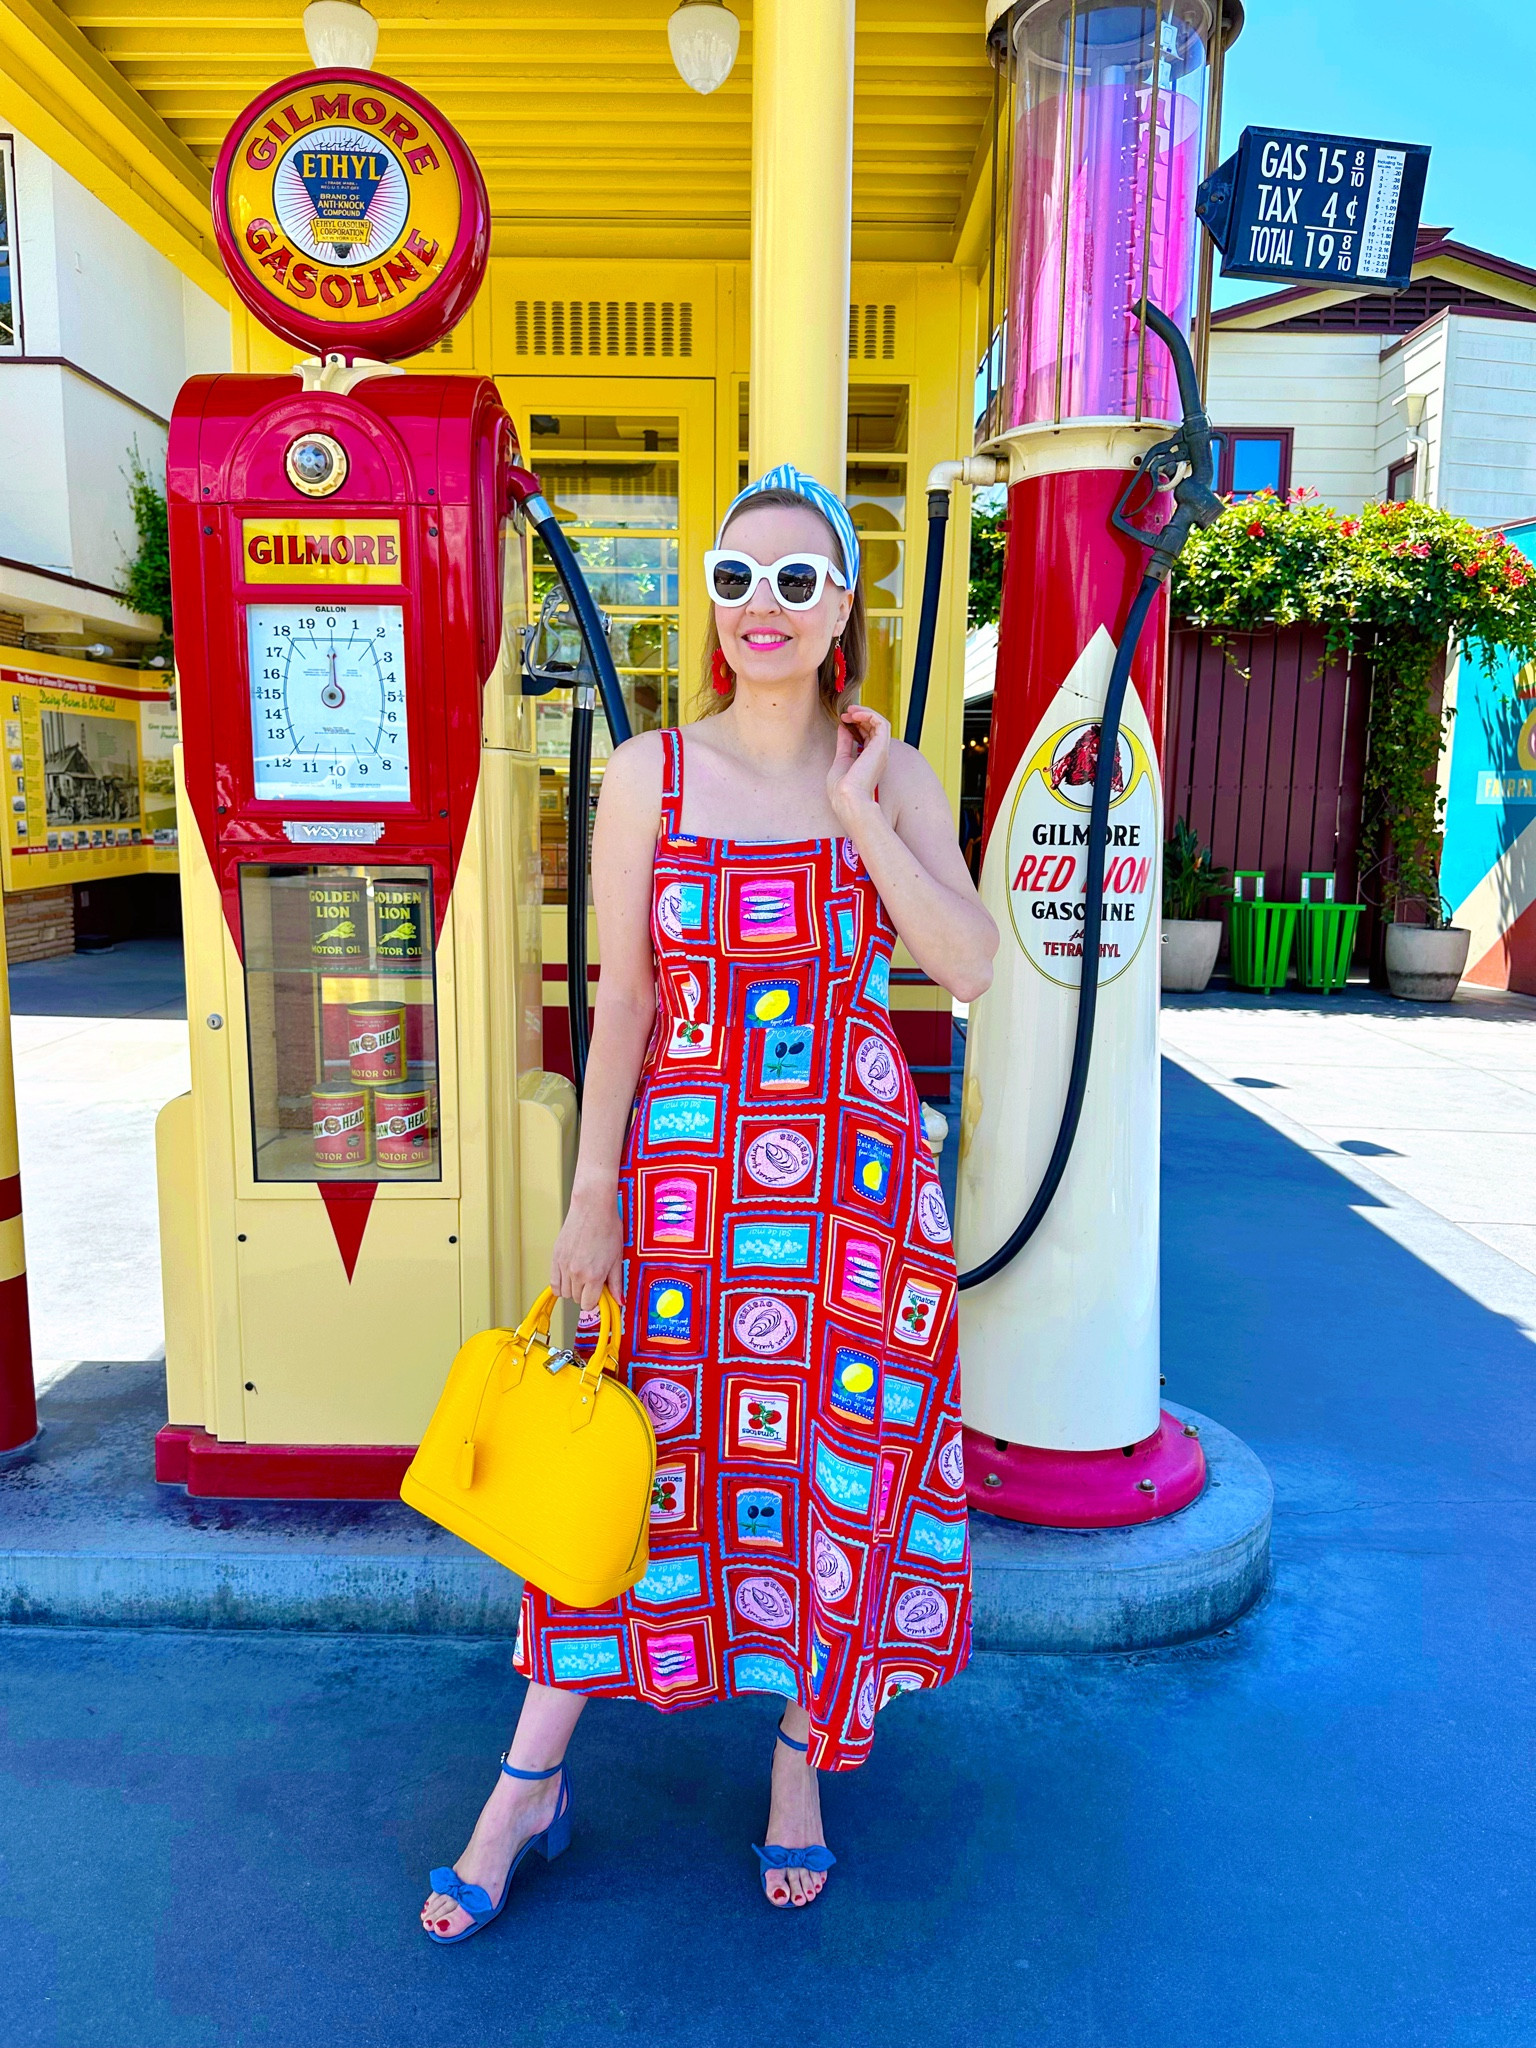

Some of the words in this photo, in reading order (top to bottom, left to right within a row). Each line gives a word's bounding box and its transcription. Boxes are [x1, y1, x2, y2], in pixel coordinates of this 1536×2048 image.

[245, 93, 440, 176] GILMORE
[314, 135, 369, 149] with
[302, 153, 381, 180] ETHYL
[1261, 141, 1308, 181] GAS
[1318, 147, 1347, 184] 15
[318, 200, 365, 210] ANTI-KNOCK
[1258, 184, 1303, 224] TAX
[320, 228, 364, 236] CORPORATION
[1250, 226, 1294, 266] TOTAL
[1304, 232, 1334, 269] 19
[245, 218, 440, 310] GASOLINE
[248, 535, 398, 565] GILMORE
[298, 618, 316, 629] 19
[327, 617, 336, 628] 0
[352, 620, 359, 630] 1
[273, 626, 290, 636] 18
[376, 627, 386, 638] 2
[266, 647, 282, 657] 17
[384, 652, 393, 662] 3
[263, 669, 280, 679] 16
[386, 672, 396, 682] 4
[264, 689, 281, 699] 15
[387, 692, 396, 702] 5
[265, 709, 282, 719] 14
[387, 712, 397, 722] 6
[267, 729, 285, 739] 13
[389, 733, 398, 744] 7
[274, 757, 291, 768] 12
[303, 762, 318, 773] 11
[382, 760, 392, 770] 8
[328, 766, 346, 776] 10
[359, 764, 368, 775] 9
[1484, 778, 1536, 798] FAIRFA
[302, 825, 365, 840] Wayne
[1012, 854, 1077, 892] RED
[309, 890, 360, 903] GOLDEN
[374, 892, 422, 904] GOLDEN
[316, 906, 350, 918] LION
[379, 907, 410, 919] LION
[1032, 901, 1135, 921] GASOINE
[312, 945, 343, 954] MOTOR
[346, 945, 361, 954] OIL
[407, 946, 423, 955] OIL
[1043, 942, 1121, 958] TETRAHYL
[379, 1028, 400, 1046] HEAD
[352, 1069, 378, 1078] MOTOR
[383, 1069, 396, 1077] OIL
[343, 1110, 364, 1129] HEAD
[346, 1151, 360, 1159] OIL
[379, 1152, 407, 1160] MOTOR
[412, 1151, 424, 1160] OIL
[908, 1290, 936, 1306] Tomatoes
[742, 1428, 782, 1440] Tomatoes
[847, 1468, 860, 1477] Sal
